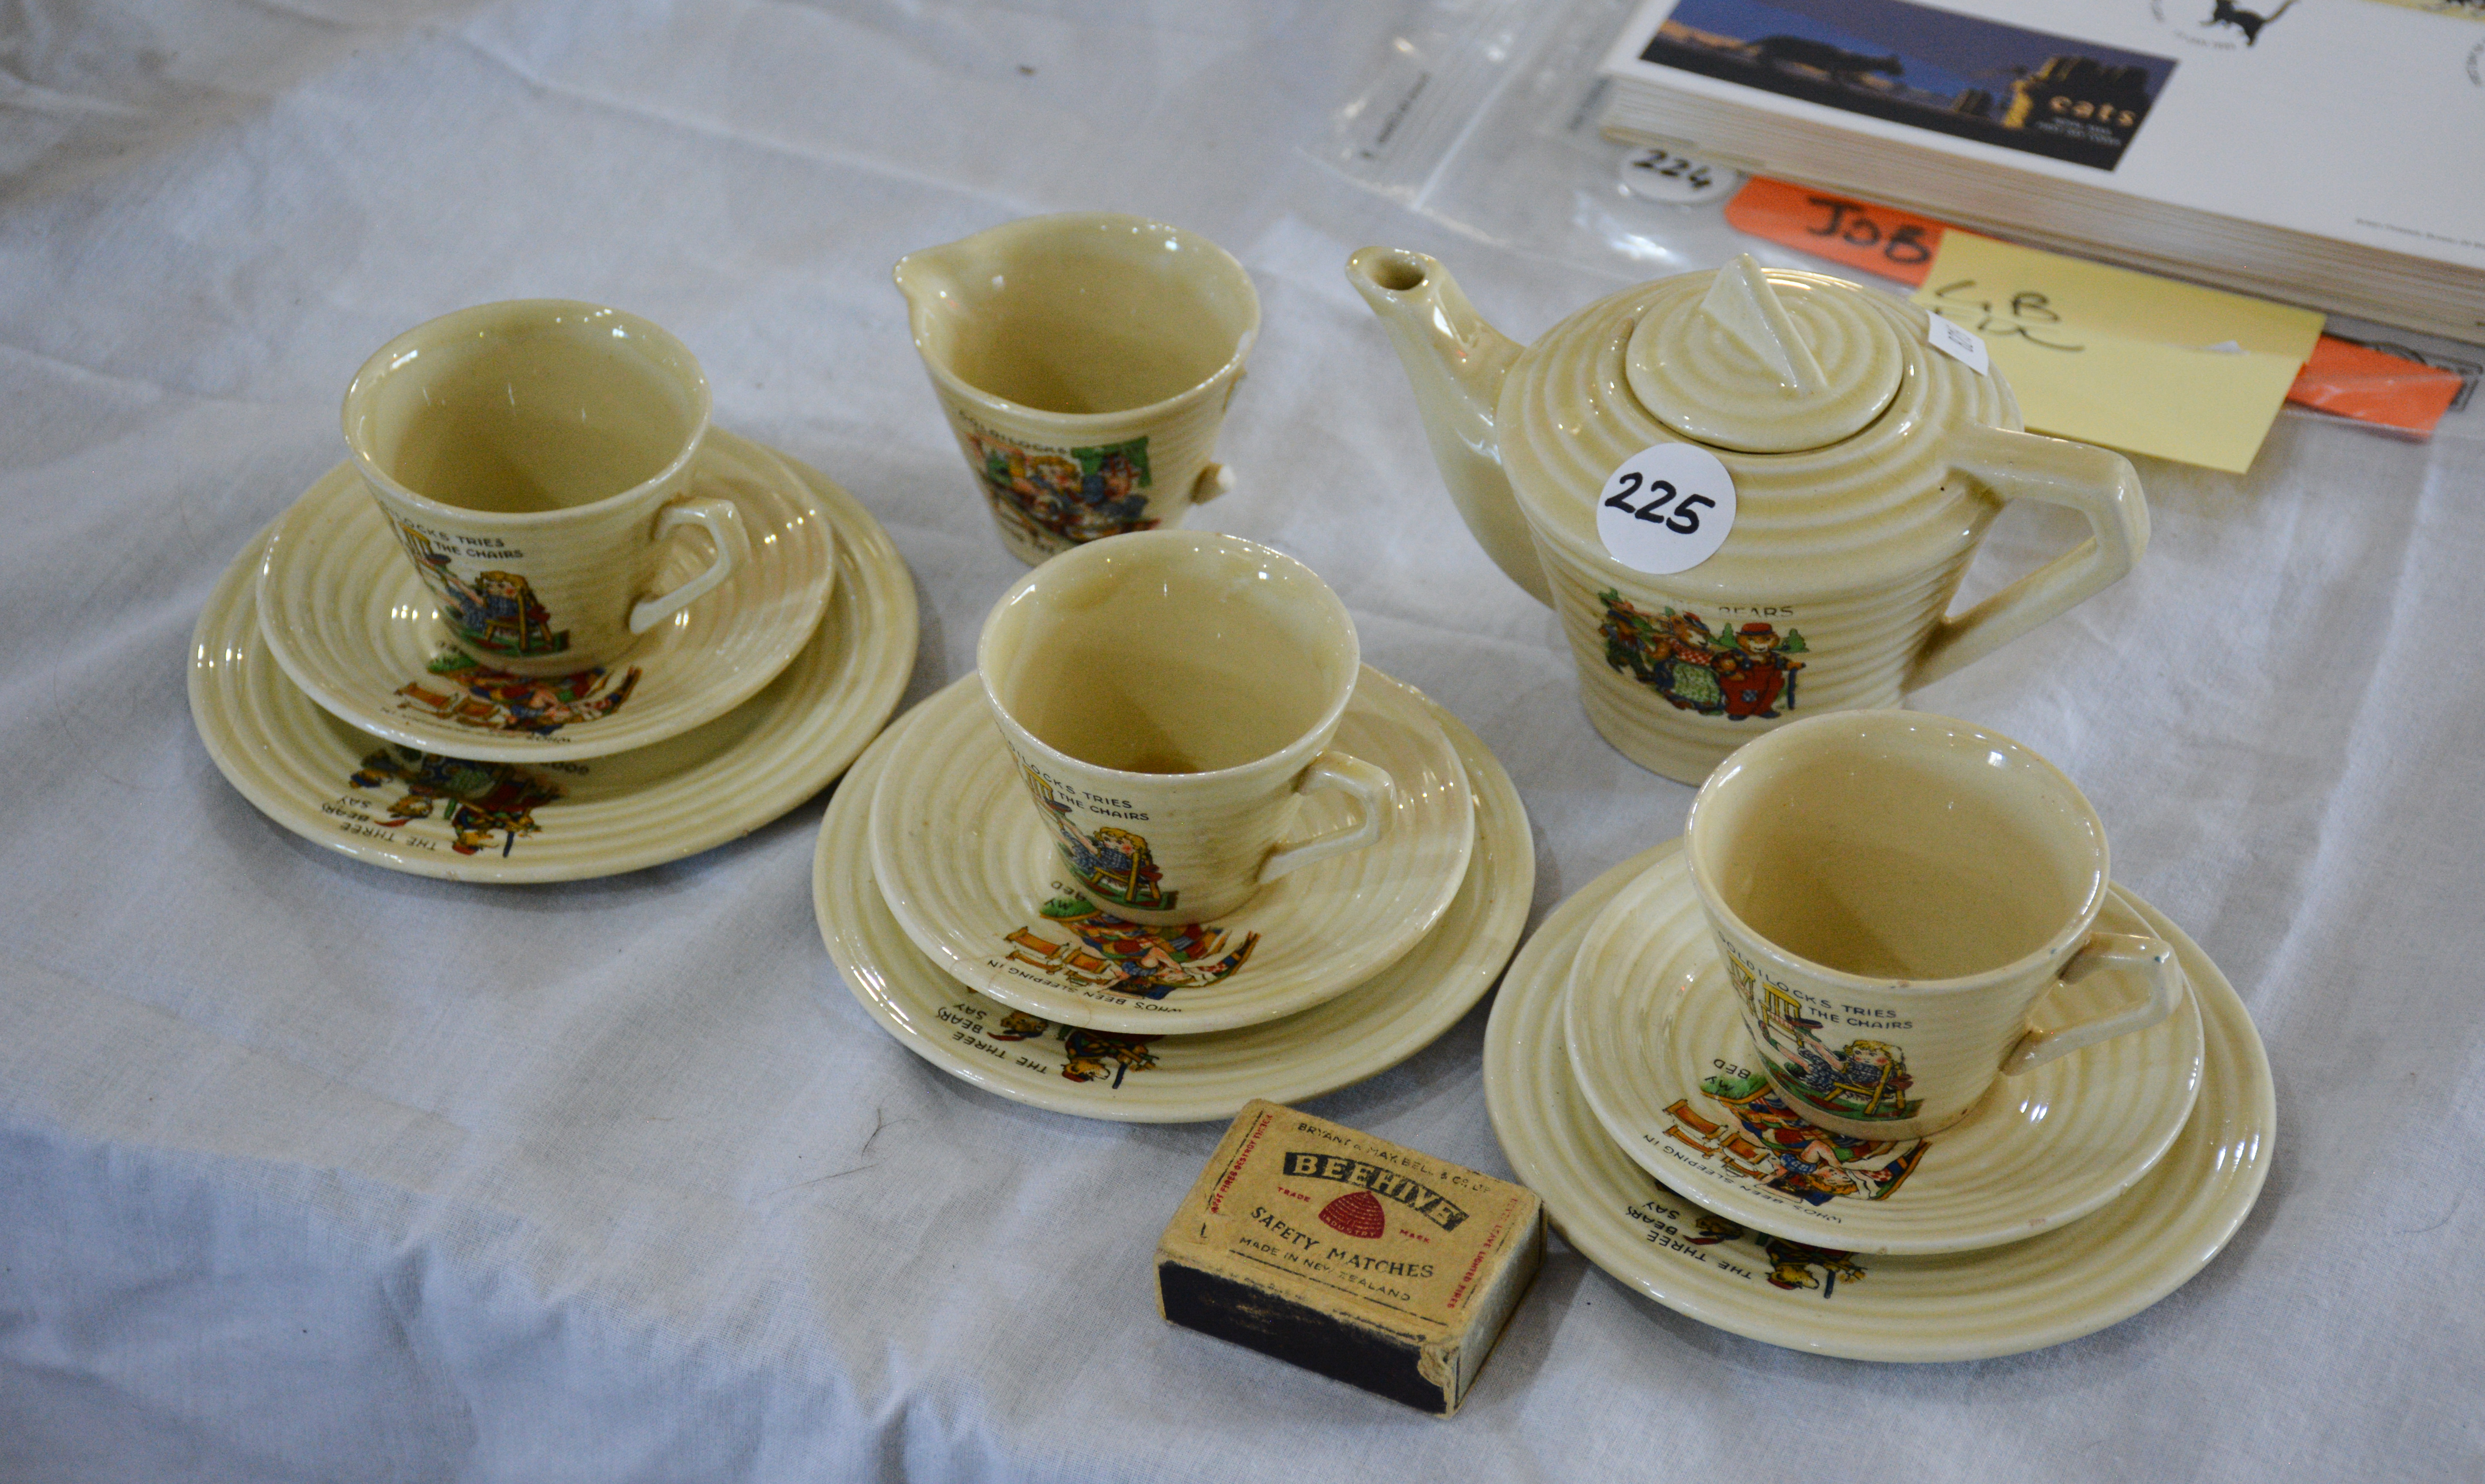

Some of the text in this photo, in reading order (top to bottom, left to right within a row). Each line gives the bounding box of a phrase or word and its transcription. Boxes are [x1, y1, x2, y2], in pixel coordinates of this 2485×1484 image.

[2049, 95, 2136, 127] cats
[1633, 150, 1712, 191] 224
[1807, 196, 1930, 265] JOB
[1605, 472, 1715, 534] 225
[435, 541, 523, 559] THE CHAIRS
[457, 535, 505, 547] TRIES
[337, 796, 372, 808] SAY
[1058, 791, 1149, 821] THE CHAIRS
[1083, 791, 1132, 809] TRIES
[340, 822, 436, 852] THE THREE
[988, 959, 1181, 1013] WHO'S BEEN SLEEPING IN
[1719, 931, 1896, 1018] GOLDILOCKS TRIES
[937, 1007, 984, 1033] BEARS
[953, 1004, 988, 1020] SAY
[1809, 1007, 1913, 1029] THE CHAIRS
[952, 1033, 1047, 1073] THE THREE
[1704, 1076, 1734, 1092] MY
[1713, 1058, 1751, 1080] BED
[1298, 1123, 1351, 1146] BRYANT
[1441, 1172, 1448, 1180] &
[1643, 1134, 1660, 1145] IN
[1220, 1171, 1238, 1193] FIRES
[1234, 1140, 1257, 1171] DESTROY
[1663, 1146, 1735, 1183] SLEEPING
[1293, 1154, 1460, 1225] BEEHIVE
[1740, 1185, 1785, 1204] BEEN
[1277, 1186, 1431, 1244] TRADE MARK
[1625, 1206, 1678, 1236] BEARS
[1642, 1201, 1680, 1219] SAY
[1251, 1206, 1434, 1278] SAFETY MATCHES
[1647, 1230, 1752, 1279] THE THREE
[1240, 1237, 1411, 1302] MADE IN NEW ZEALAND
[1463, 1251, 1487, 1283] LIGHTED
[1447, 1284, 1466, 1309] FIRES
